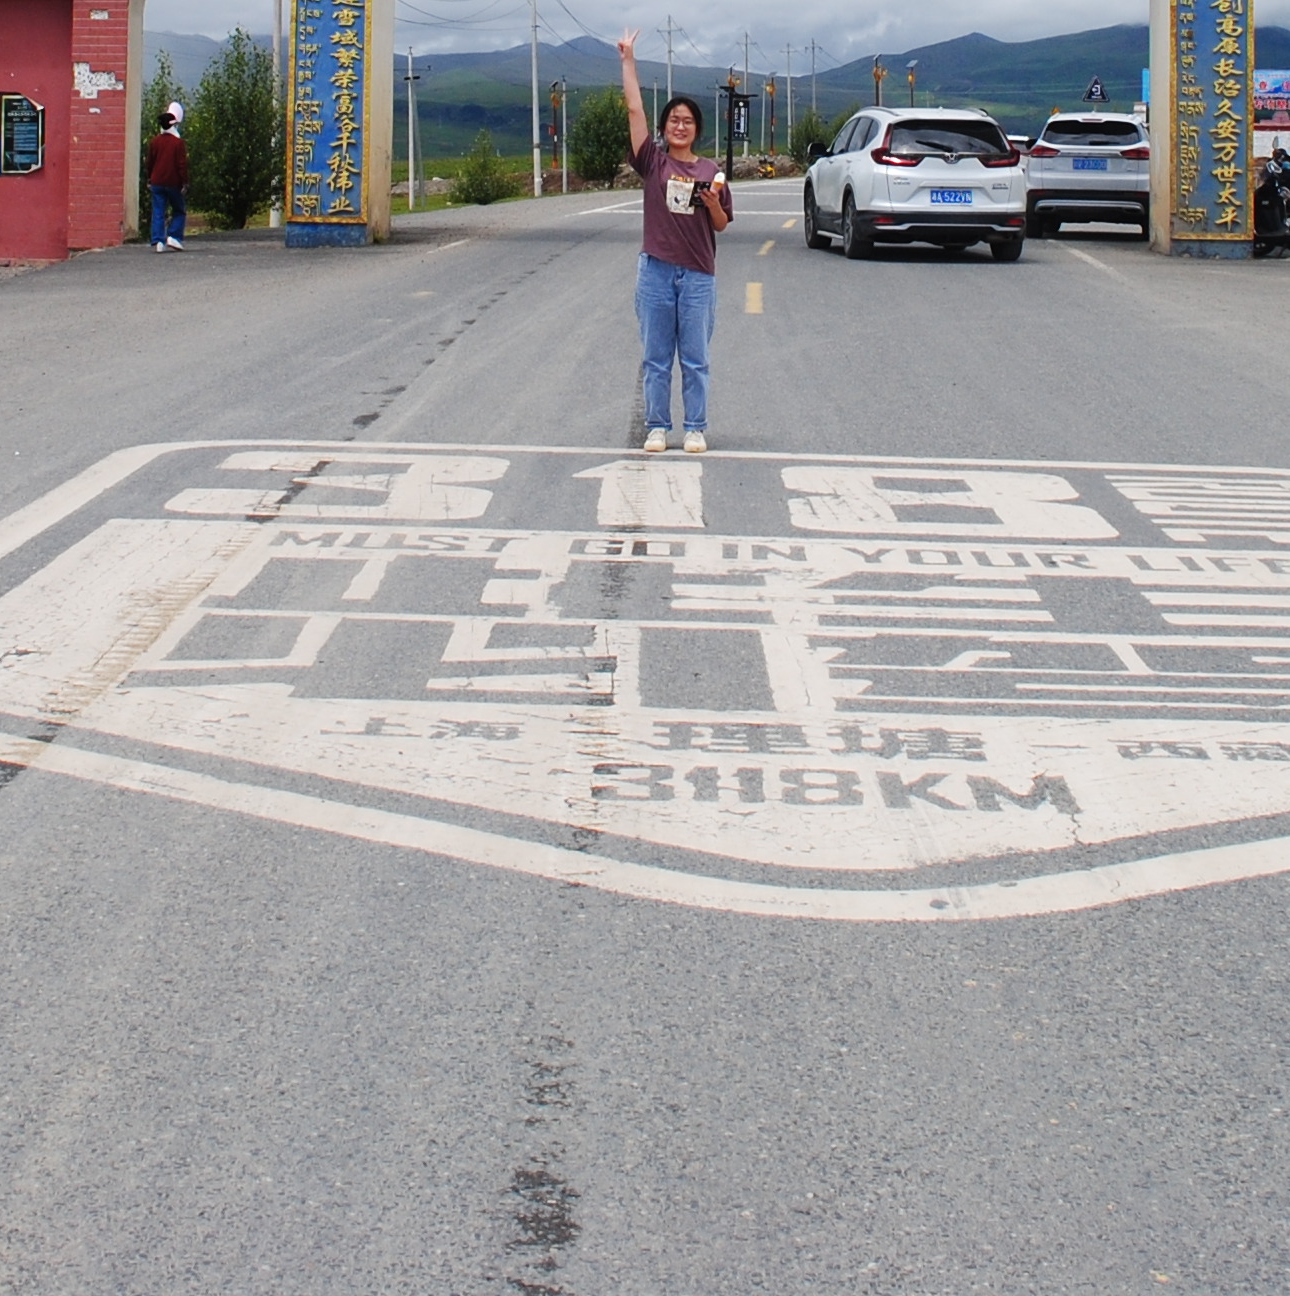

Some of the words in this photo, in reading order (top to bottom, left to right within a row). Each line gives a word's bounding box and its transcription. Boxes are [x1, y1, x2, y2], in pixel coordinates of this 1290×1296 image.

[164, 450, 1120, 539] 318
[264, 529, 527, 554] MUST
[570, 537, 686, 558] GO
[721, 543, 808, 563] IN
[843, 546, 1094, 571] YOUR
[652, 719, 987, 762] 理塘
